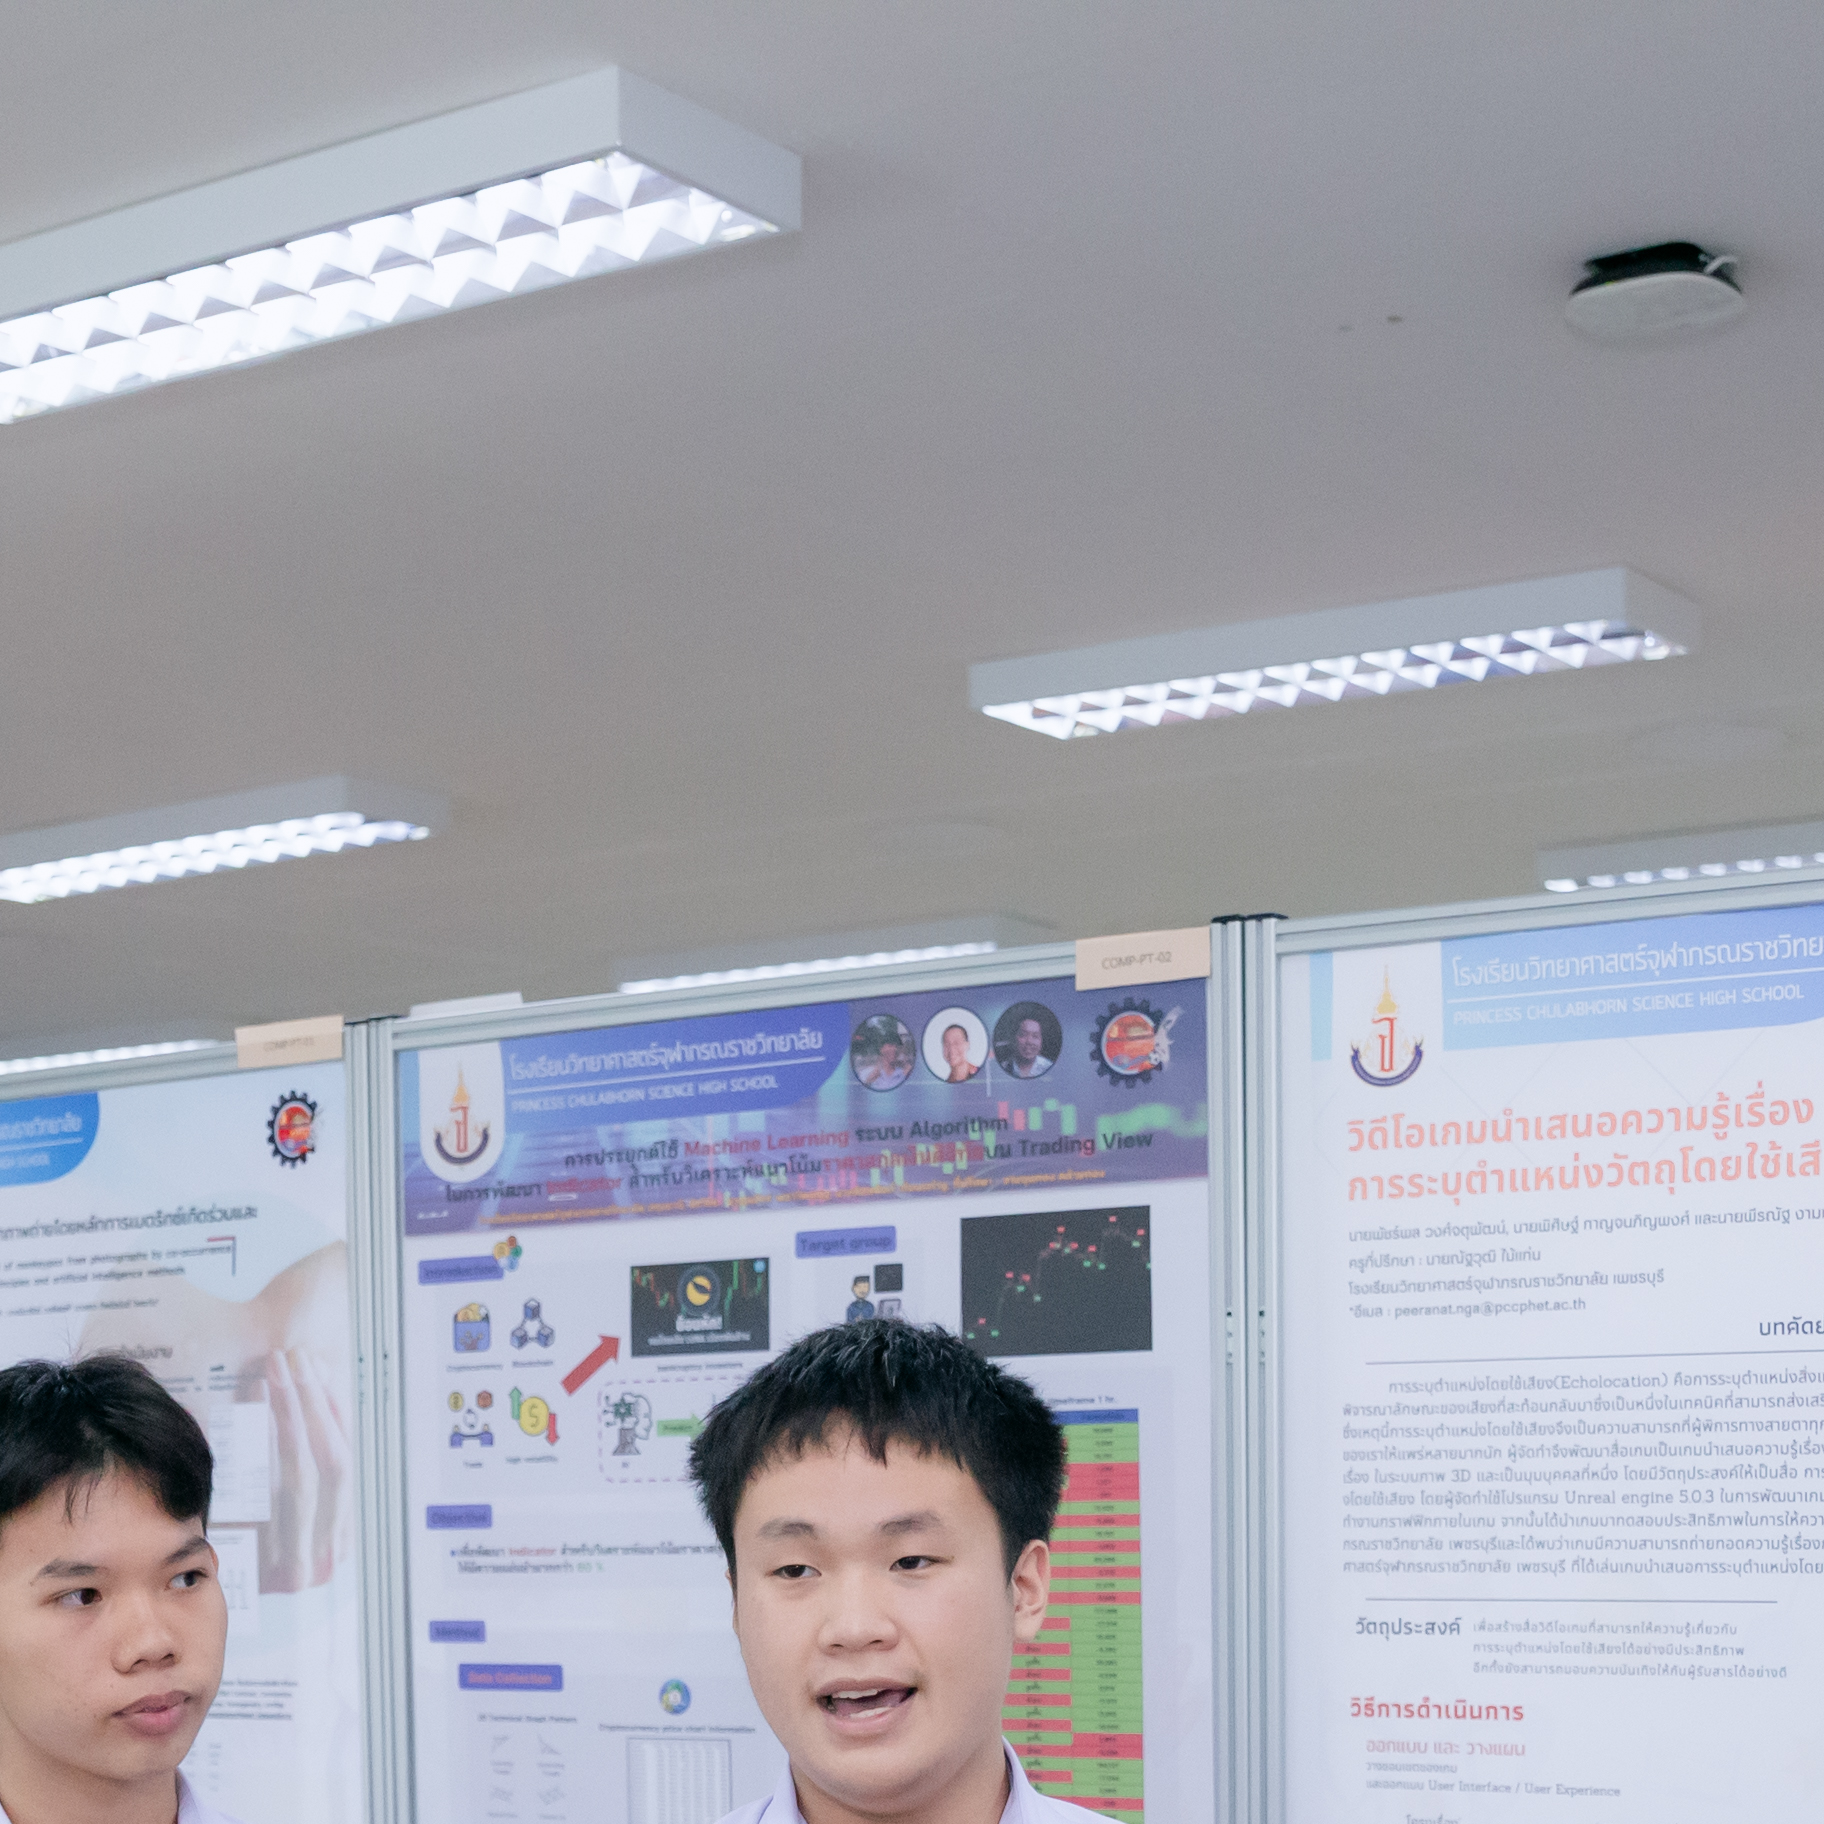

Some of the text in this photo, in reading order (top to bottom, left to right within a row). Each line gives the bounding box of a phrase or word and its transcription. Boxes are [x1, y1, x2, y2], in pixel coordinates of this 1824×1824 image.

[1101, 951, 1172, 970] COMP-PT-02
[1453, 982, 1805, 1026] PRINCESS CHULABHORN SCIENCE HIGH SCHOOL
[685, 1136, 761, 1158] Machine
[767, 1128, 849, 1154] Learning
[909, 1117, 1008, 1142] Algorithm
[1019, 1137, 1095, 1158] Trading
[1102, 1131, 1153, 1151] View
[1350, 1696, 1525, 1721] วิธีการดำเนินการ
